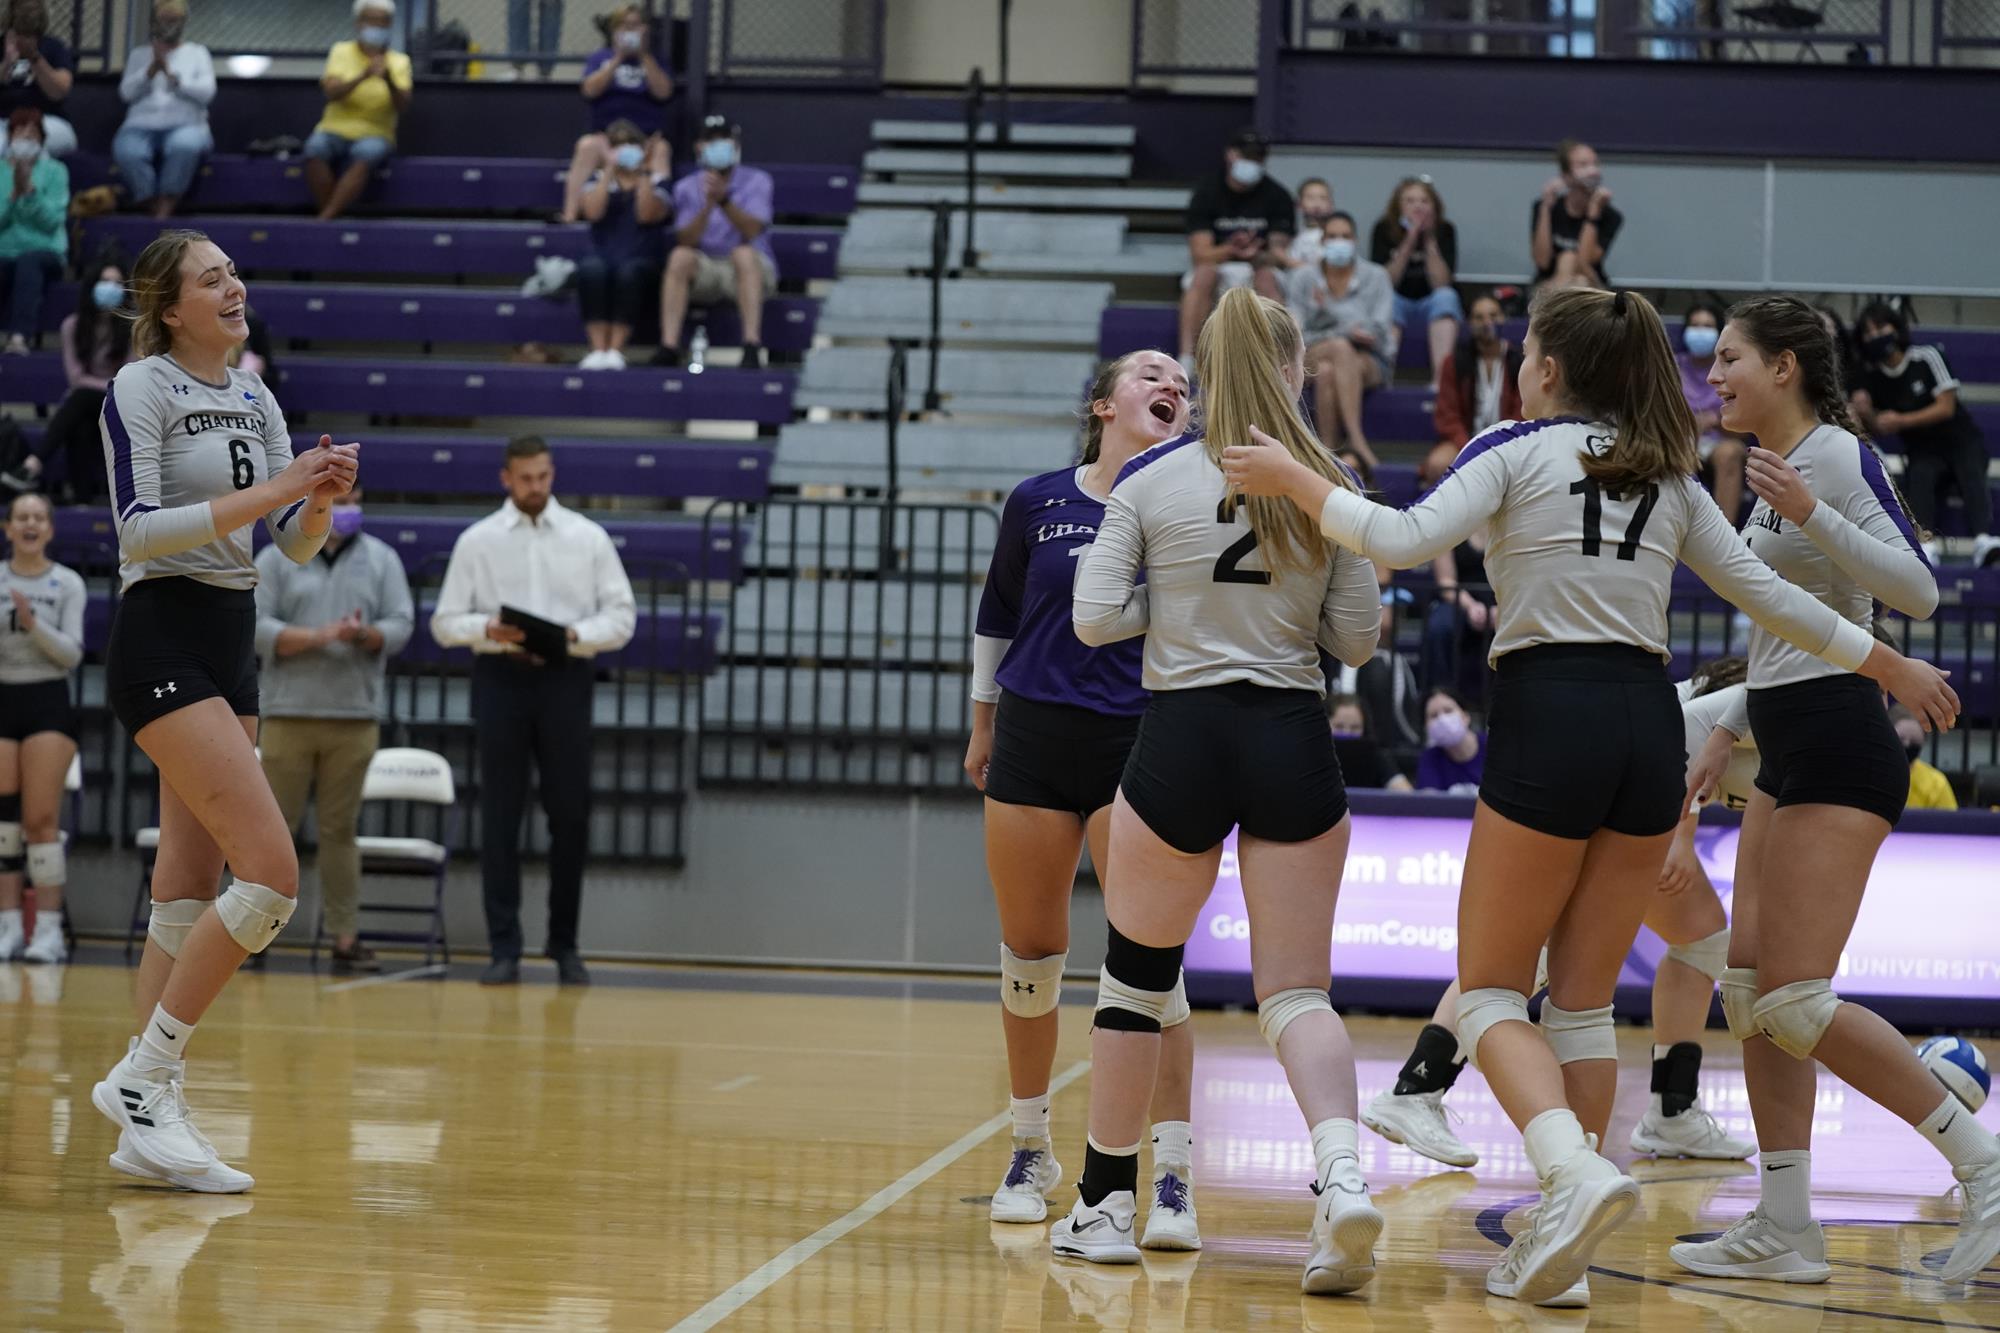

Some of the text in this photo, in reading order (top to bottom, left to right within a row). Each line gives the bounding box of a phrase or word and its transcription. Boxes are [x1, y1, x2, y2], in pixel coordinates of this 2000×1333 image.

[228, 439, 255, 490] 6
[1212, 493, 1272, 585] 2
[1569, 474, 1660, 562] 17
